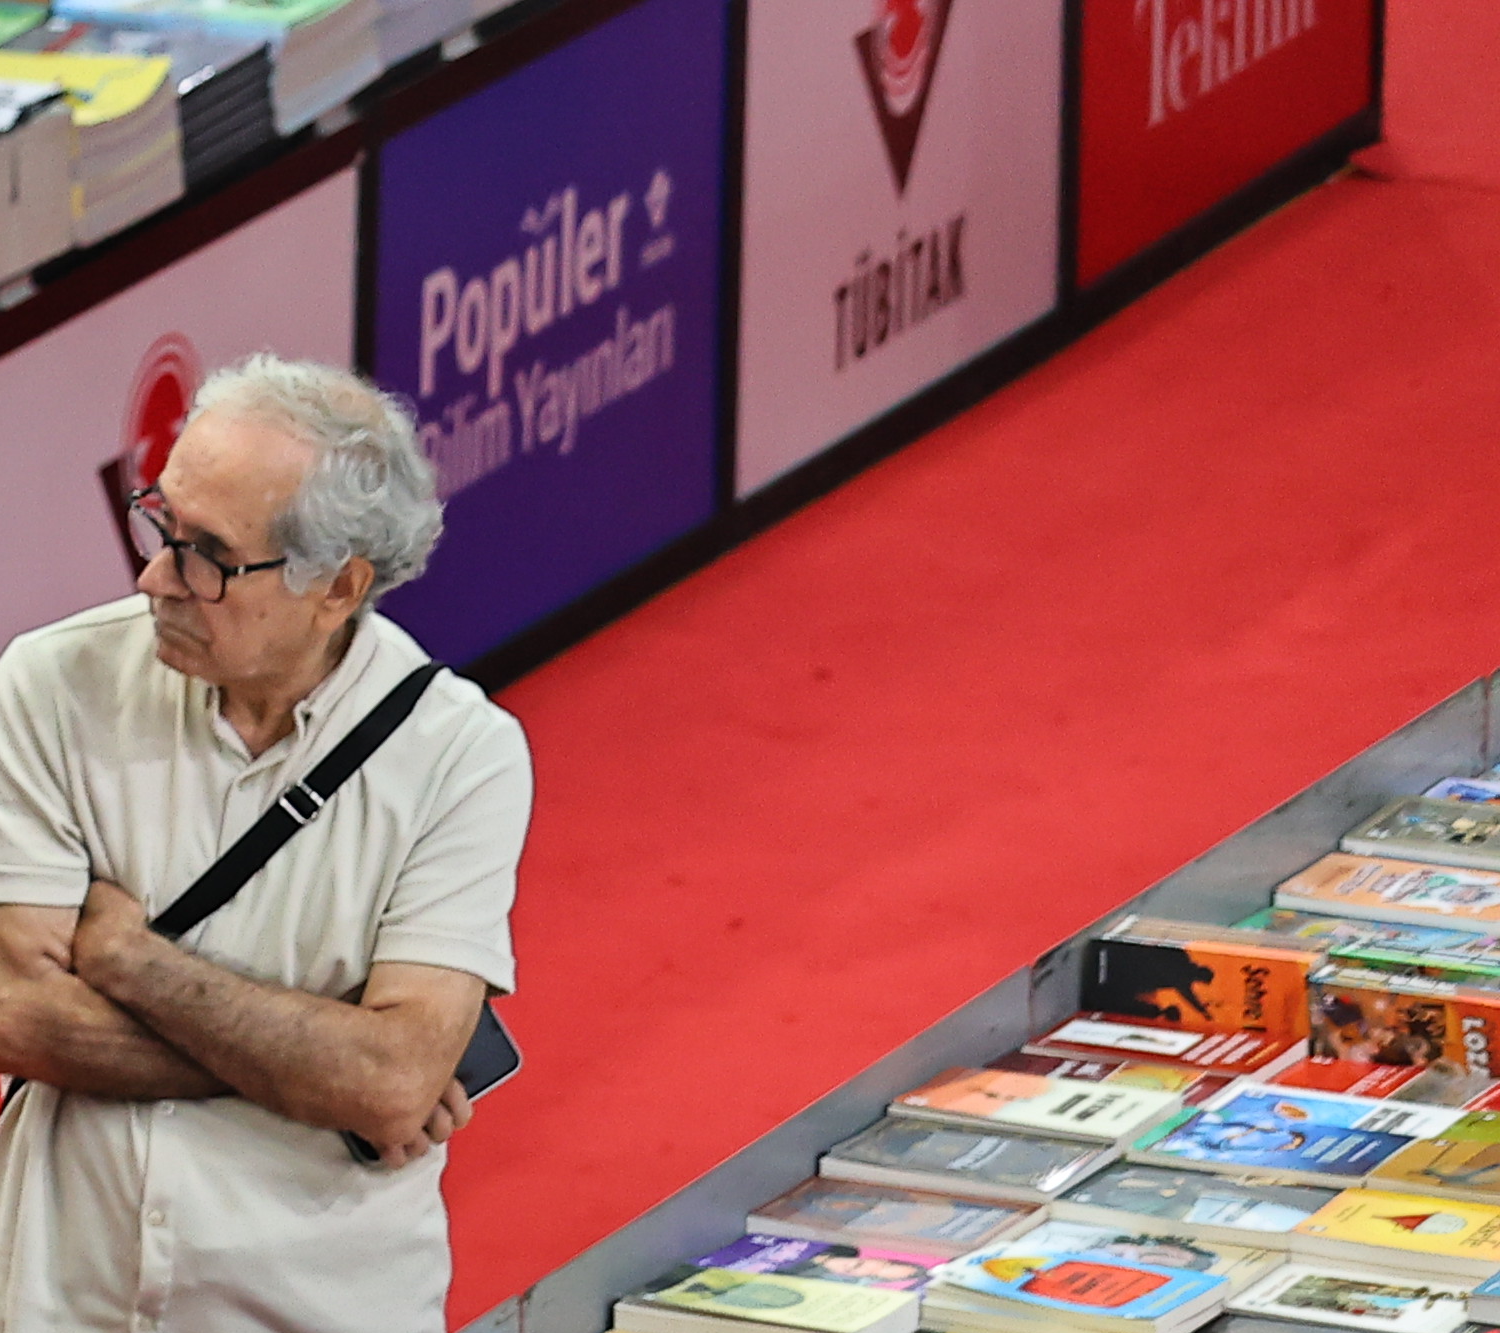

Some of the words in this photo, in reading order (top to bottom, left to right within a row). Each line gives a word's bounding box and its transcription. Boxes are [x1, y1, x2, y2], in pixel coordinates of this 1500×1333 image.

[419, 184, 632, 395] Popüler
[834, 216, 966, 373] TÜBİTAK
[516, 304, 674, 458] Yayınları
